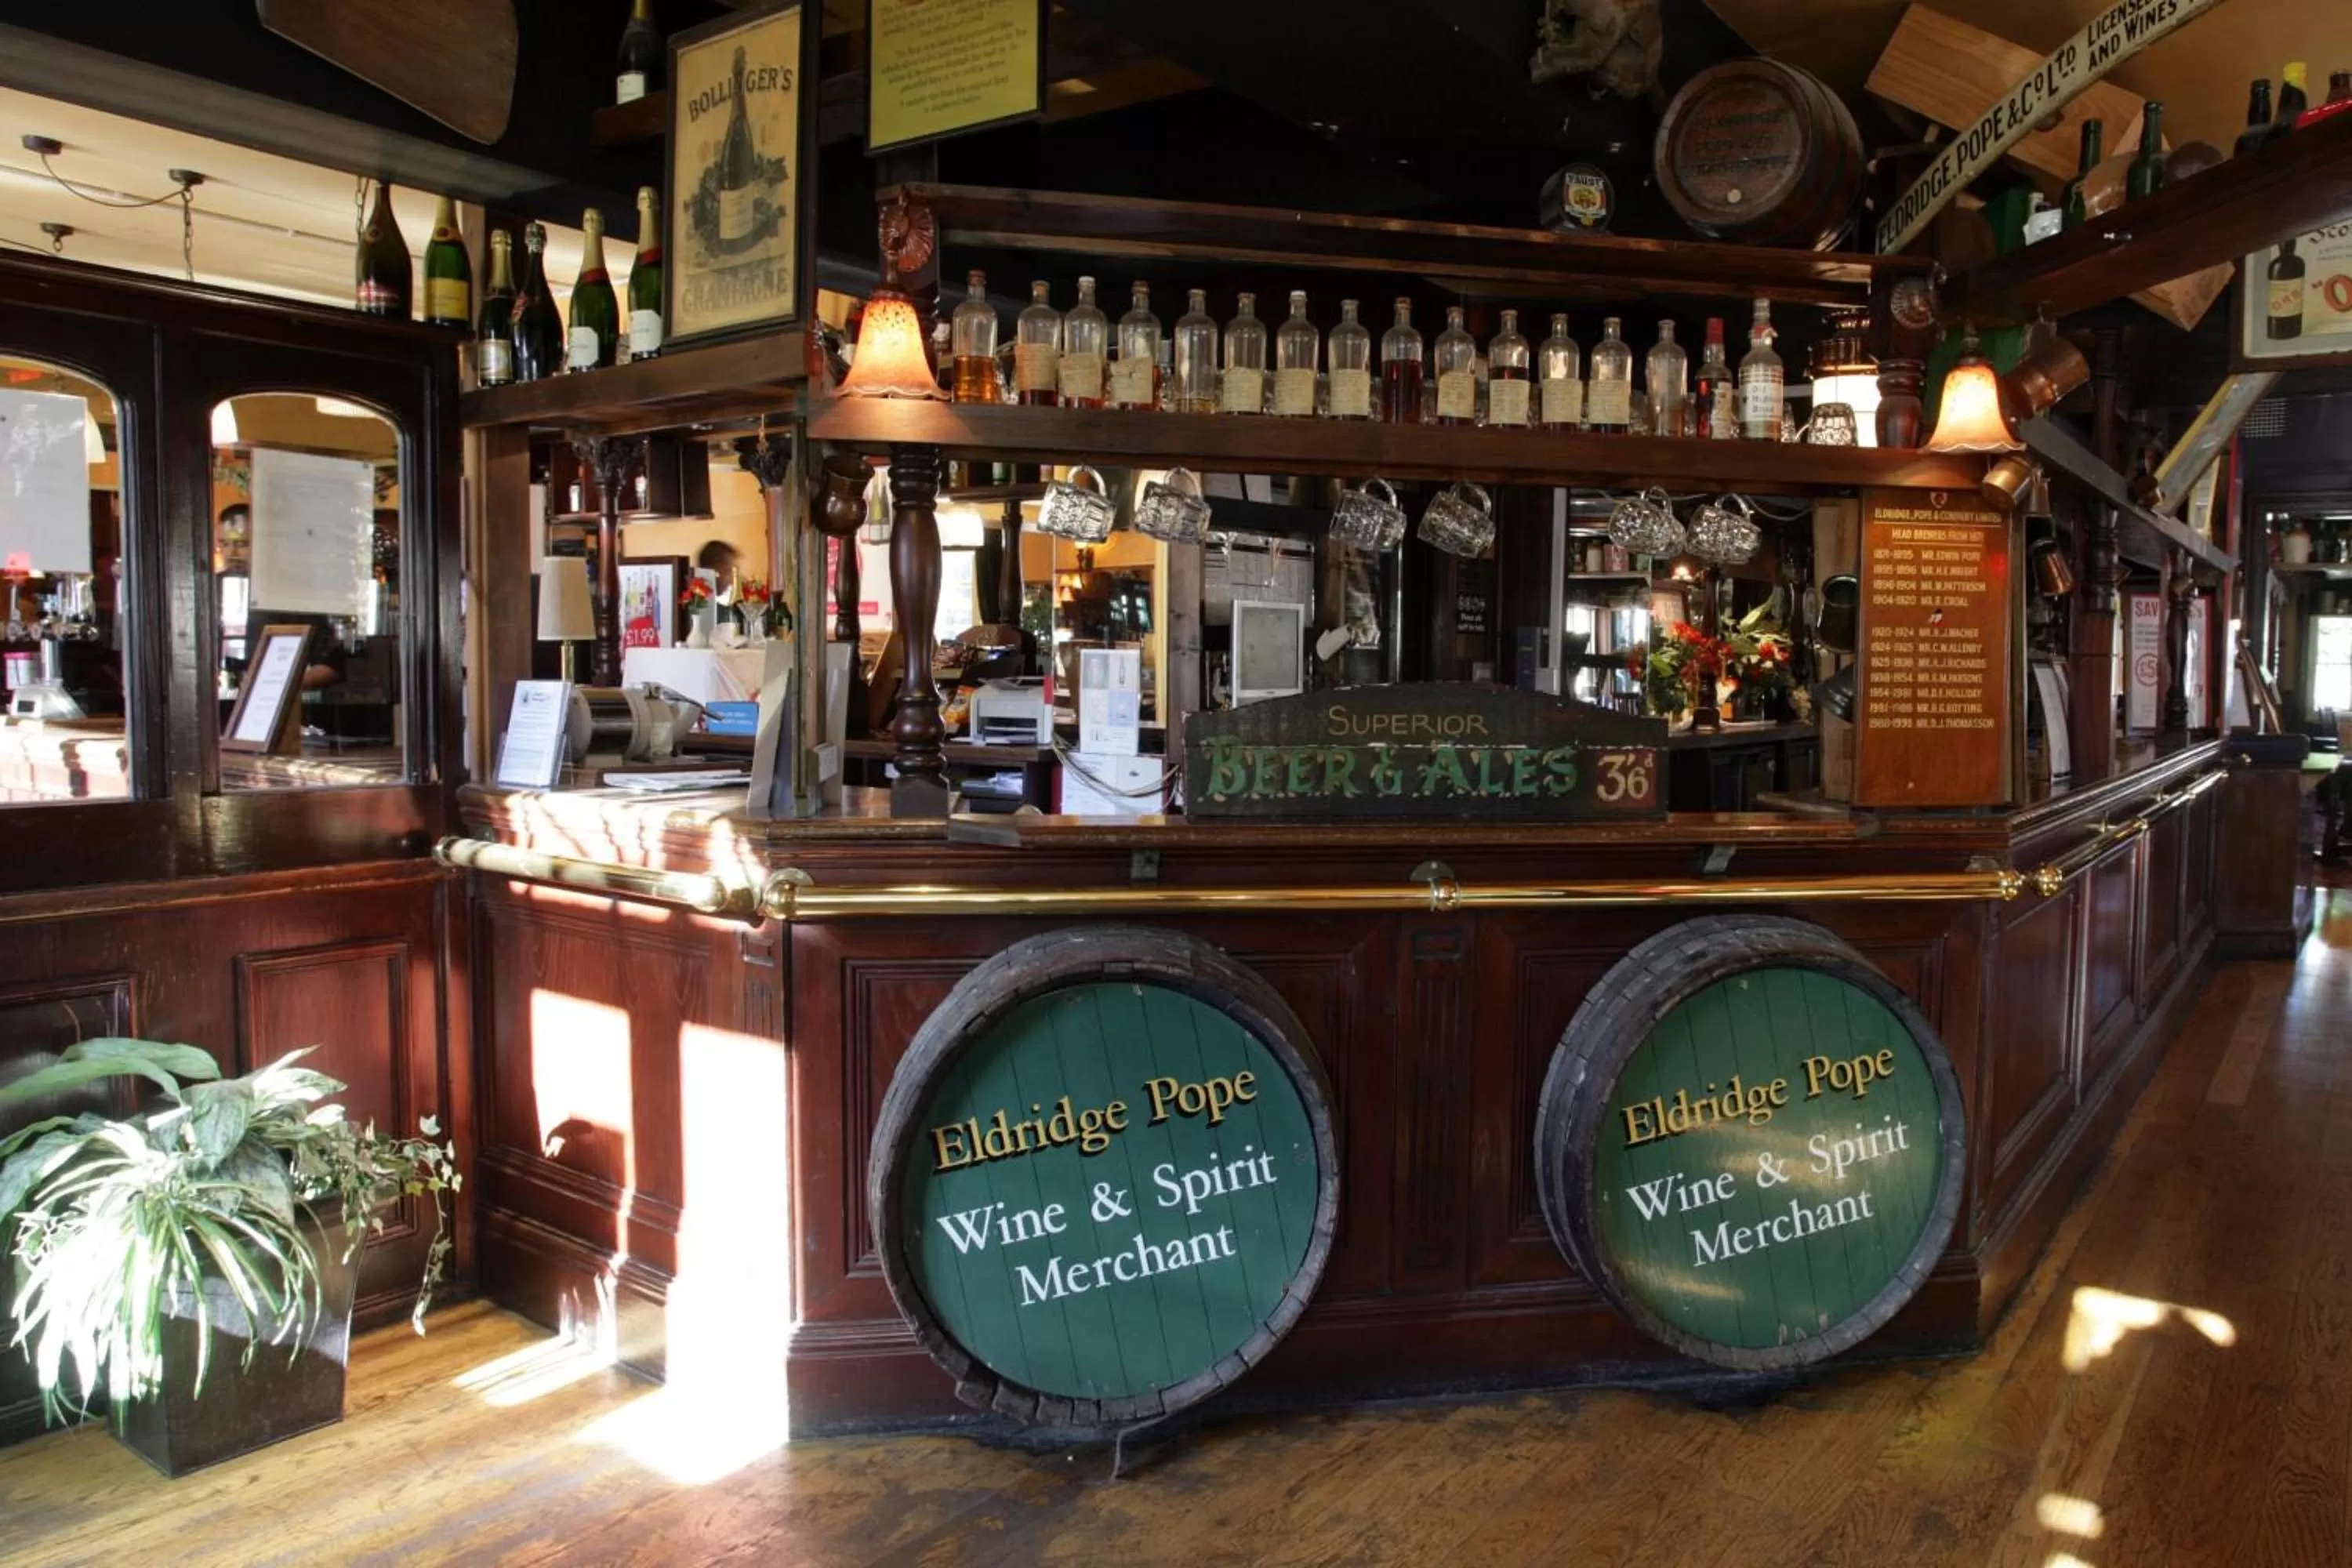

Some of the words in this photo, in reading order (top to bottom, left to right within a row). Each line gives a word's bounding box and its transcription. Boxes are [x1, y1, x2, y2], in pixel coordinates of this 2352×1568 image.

[2088, 34, 2121, 72] AND
[2124, 0, 2177, 42] WINES
[1957, 106, 2006, 174] POPE
[2007, 97, 2024, 129] &
[1892, 528, 1912, 539] HEAD
[2135, 601, 2158, 618] SAV
[1328, 706, 1489, 735] SUPERIOR
[1200, 735, 1363, 802] BEER
[1370, 745, 1404, 797] &
[1413, 741, 1578, 799] ALES
[933, 1095, 1129, 1172] Eldridge
[1145, 1069, 1258, 1126] Pope
[1621, 1075, 1789, 1148] Eldridge
[1802, 1047, 1895, 1099] Pope
[937, 1200, 1067, 1254] Wine
[1091, 1181, 1132, 1223] &
[1152, 1144, 1278, 1215] Spirit
[1625, 1171, 1737, 1222] Wine
[1755, 1151, 1789, 1189] &
[1808, 1114, 1911, 1180] Spirit
[1015, 1224, 1237, 1306] Merchant
[1690, 1189, 1875, 1267] Merchant
